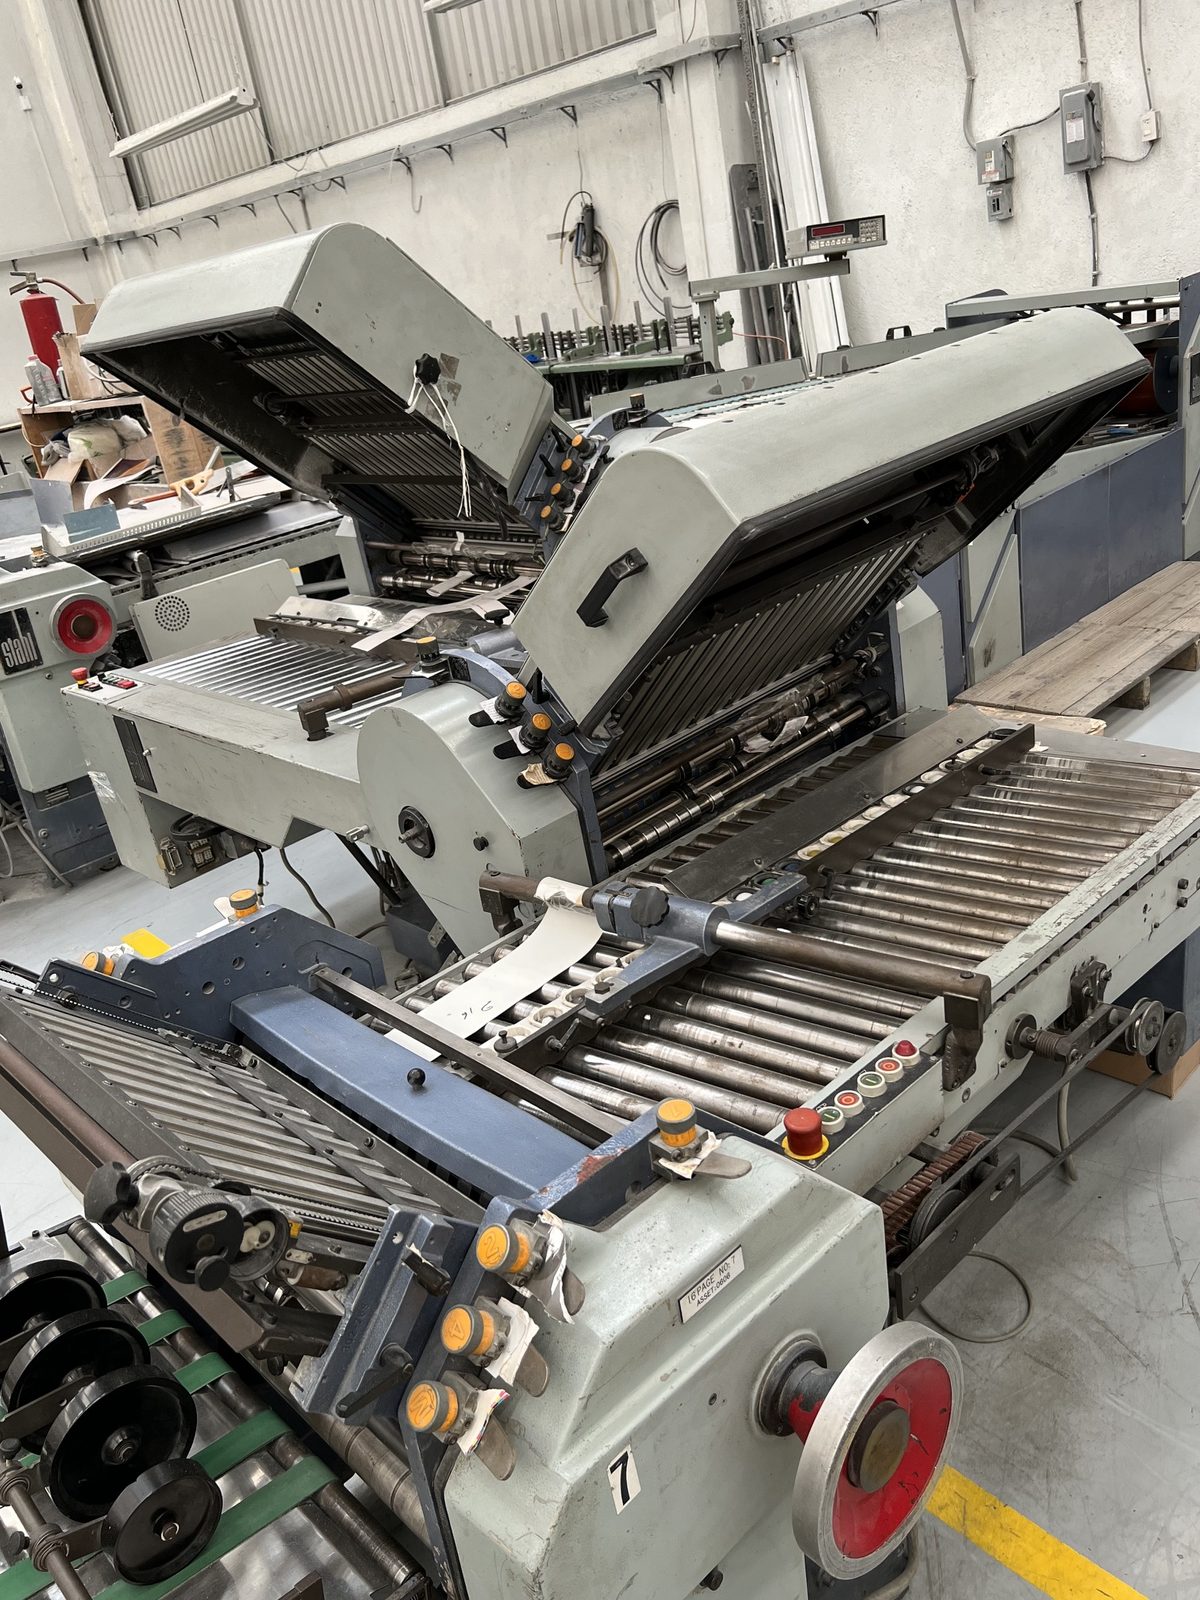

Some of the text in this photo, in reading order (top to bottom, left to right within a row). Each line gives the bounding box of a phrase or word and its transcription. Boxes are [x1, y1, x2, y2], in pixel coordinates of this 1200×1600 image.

[1, 610, 38, 668] stahl
[696, 1273, 716, 1296] PAGE
[609, 1450, 631, 1506] 7
